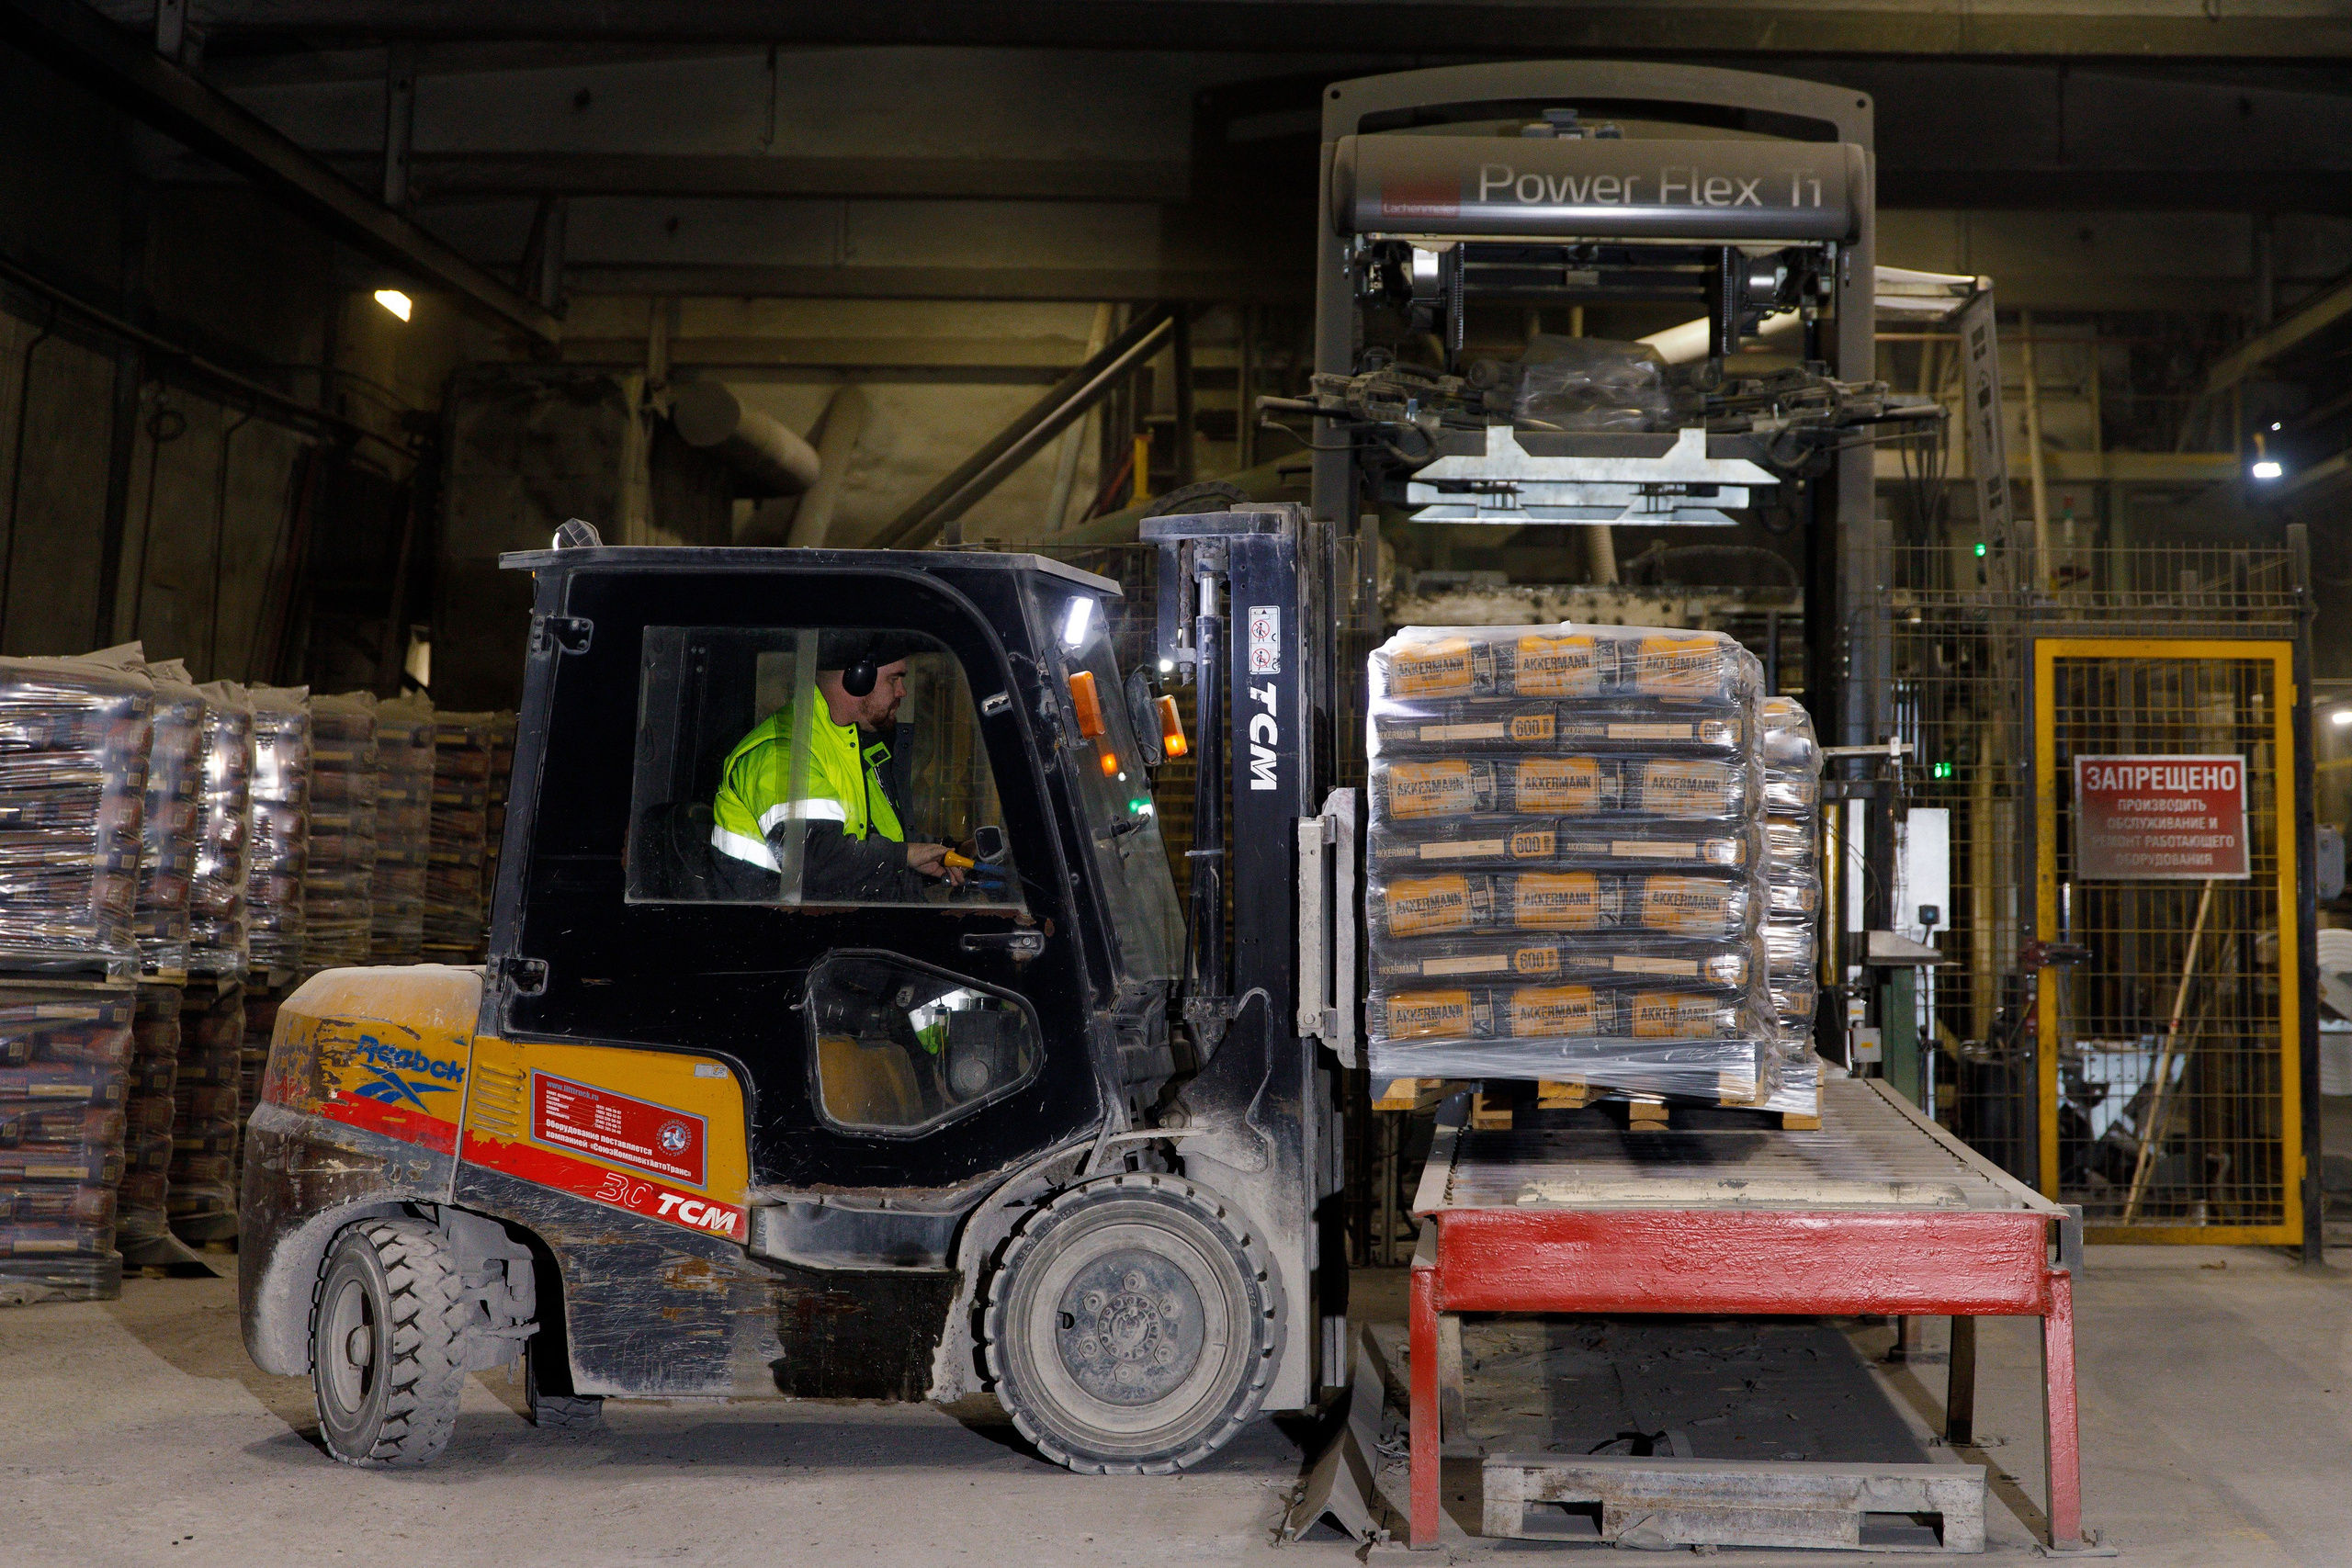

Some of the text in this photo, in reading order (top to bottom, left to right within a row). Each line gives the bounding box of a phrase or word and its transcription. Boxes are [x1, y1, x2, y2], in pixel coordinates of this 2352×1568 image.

[1479, 164, 1640, 205] Power
[1659, 166, 1763, 207] Flex
[1384, 203, 1457, 215] Lachenmeier
[1397, 658, 1464, 677] AKKERMANN
[1523, 654, 1589, 671] AKKERMANN
[1645, 657, 1713, 671] AKKERMANN
[1250, 682, 1278, 790] TCM
[1377, 730, 1416, 740] KKERMANN
[1516, 719, 1541, 737] 600
[1563, 726, 1604, 736] AKKERMANN
[1397, 777, 1464, 796] AKKERMANN
[1525, 776, 1590, 790] AKKERMANN
[1652, 776, 1719, 793] AKKERMANN
[2086, 766, 2236, 794] ЗАПРЕЩЕНО
[2118, 798, 2207, 814] ПРОИЗВОДИТЬ
[2107, 816, 2218, 830] ОБСЛУЖИВАНИЕ И
[1516, 836, 1541, 853] 600
[1566, 842, 1608, 852] AKKERMANN
[2144, 835, 2234, 849] РАБОТАЮЩЕГО
[1375, 848, 1416, 858] AKKERMANN
[2115, 852, 2213, 867] ОБОРУДОВАНИЯ
[1396, 892, 1463, 915] AKKERMANN
[1523, 892, 1590, 906] AKKERMANN
[1652, 891, 1719, 910] AKKERMANN
[1520, 952, 1544, 969] 600
[1378, 964, 1419, 976] AKKERMANN
[1396, 1004, 1464, 1023] AKKERMANN
[1520, 1004, 1588, 1021] AKKERMANN
[1641, 1007, 1709, 1021] AKKERMANN
[546, 1118, 600, 1141] Оборудование
[600, 1134, 653, 1156] поставляется
[546, 1130, 588, 1148] компанией
[657, 1192, 738, 1234] TCM
